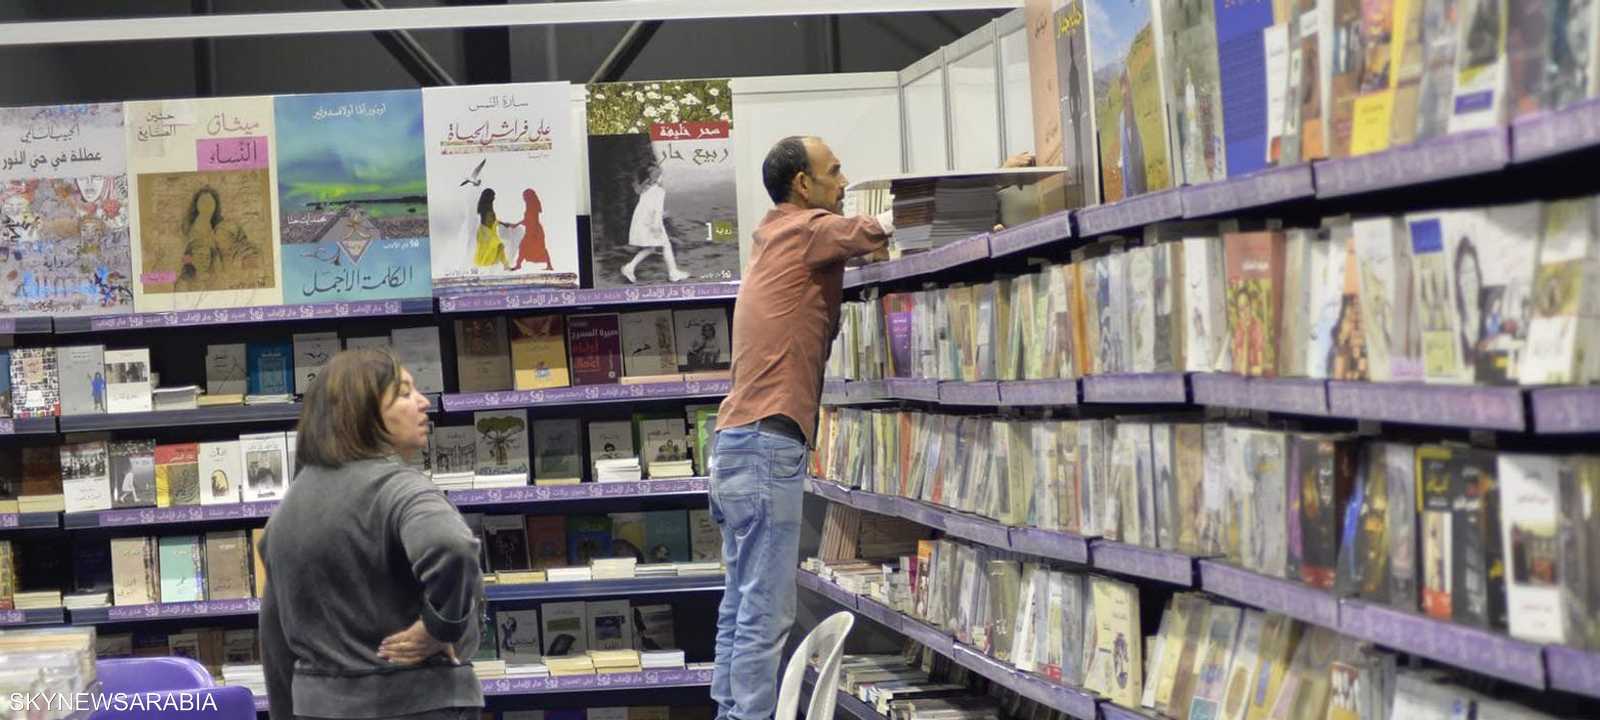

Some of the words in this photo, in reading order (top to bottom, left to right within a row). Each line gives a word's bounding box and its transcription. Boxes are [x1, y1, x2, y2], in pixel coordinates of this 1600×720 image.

[501, 94, 528, 108] سارة
[146, 112, 175, 122] حنين
[207, 112, 258, 135] ميثاق
[448, 120, 489, 143] الحياة
[480, 119, 528, 146] فراش
[527, 119, 552, 143] على
[659, 123, 691, 139] خليفة
[697, 127, 721, 139] سحر
[29, 153, 48, 172] حي
[51, 153, 67, 171] في
[71, 147, 102, 162] عطلة
[656, 143, 684, 168] حار
[692, 148, 728, 165] ربيع
[303, 268, 360, 296] الأجمل
